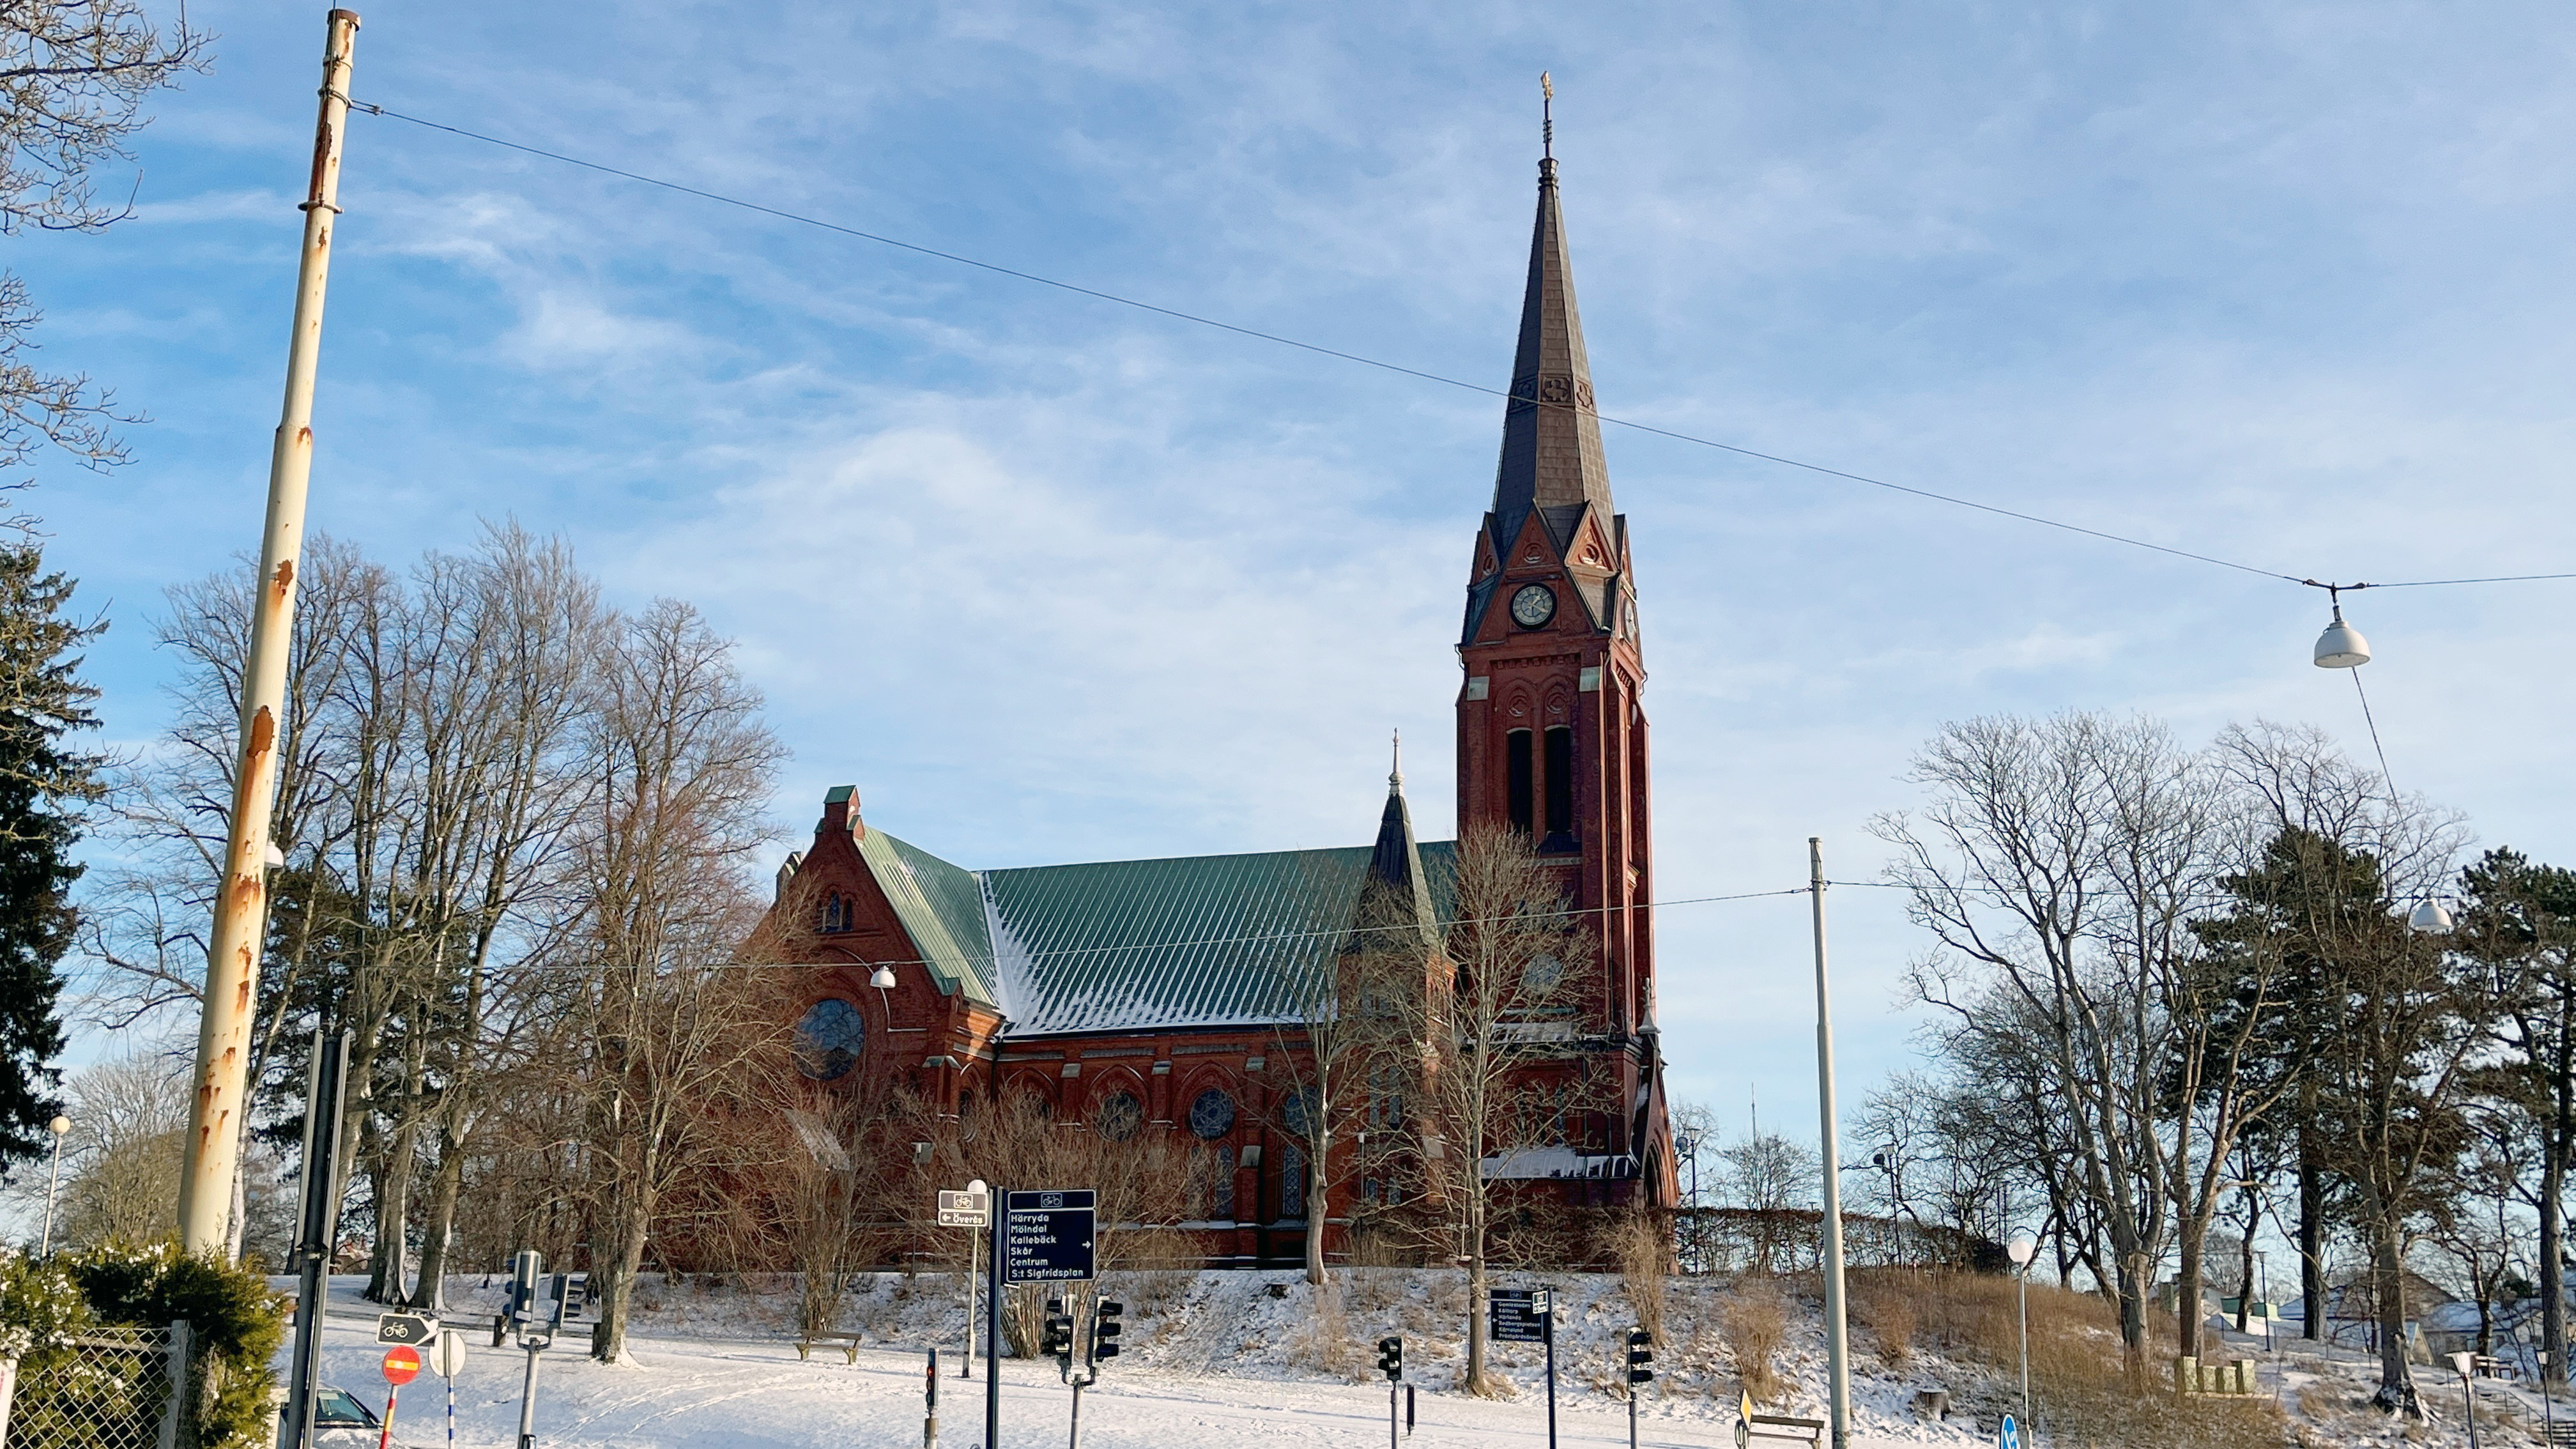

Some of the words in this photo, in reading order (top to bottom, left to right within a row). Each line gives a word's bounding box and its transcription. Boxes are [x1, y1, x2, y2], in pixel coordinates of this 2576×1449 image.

[1011, 1215, 1049, 1223] Härryda
[1011, 1225, 1046, 1233] Mölndal
[1011, 1236, 1057, 1244] Kallebäck
[1027, 1269, 1084, 1278] Sigfridsplan
